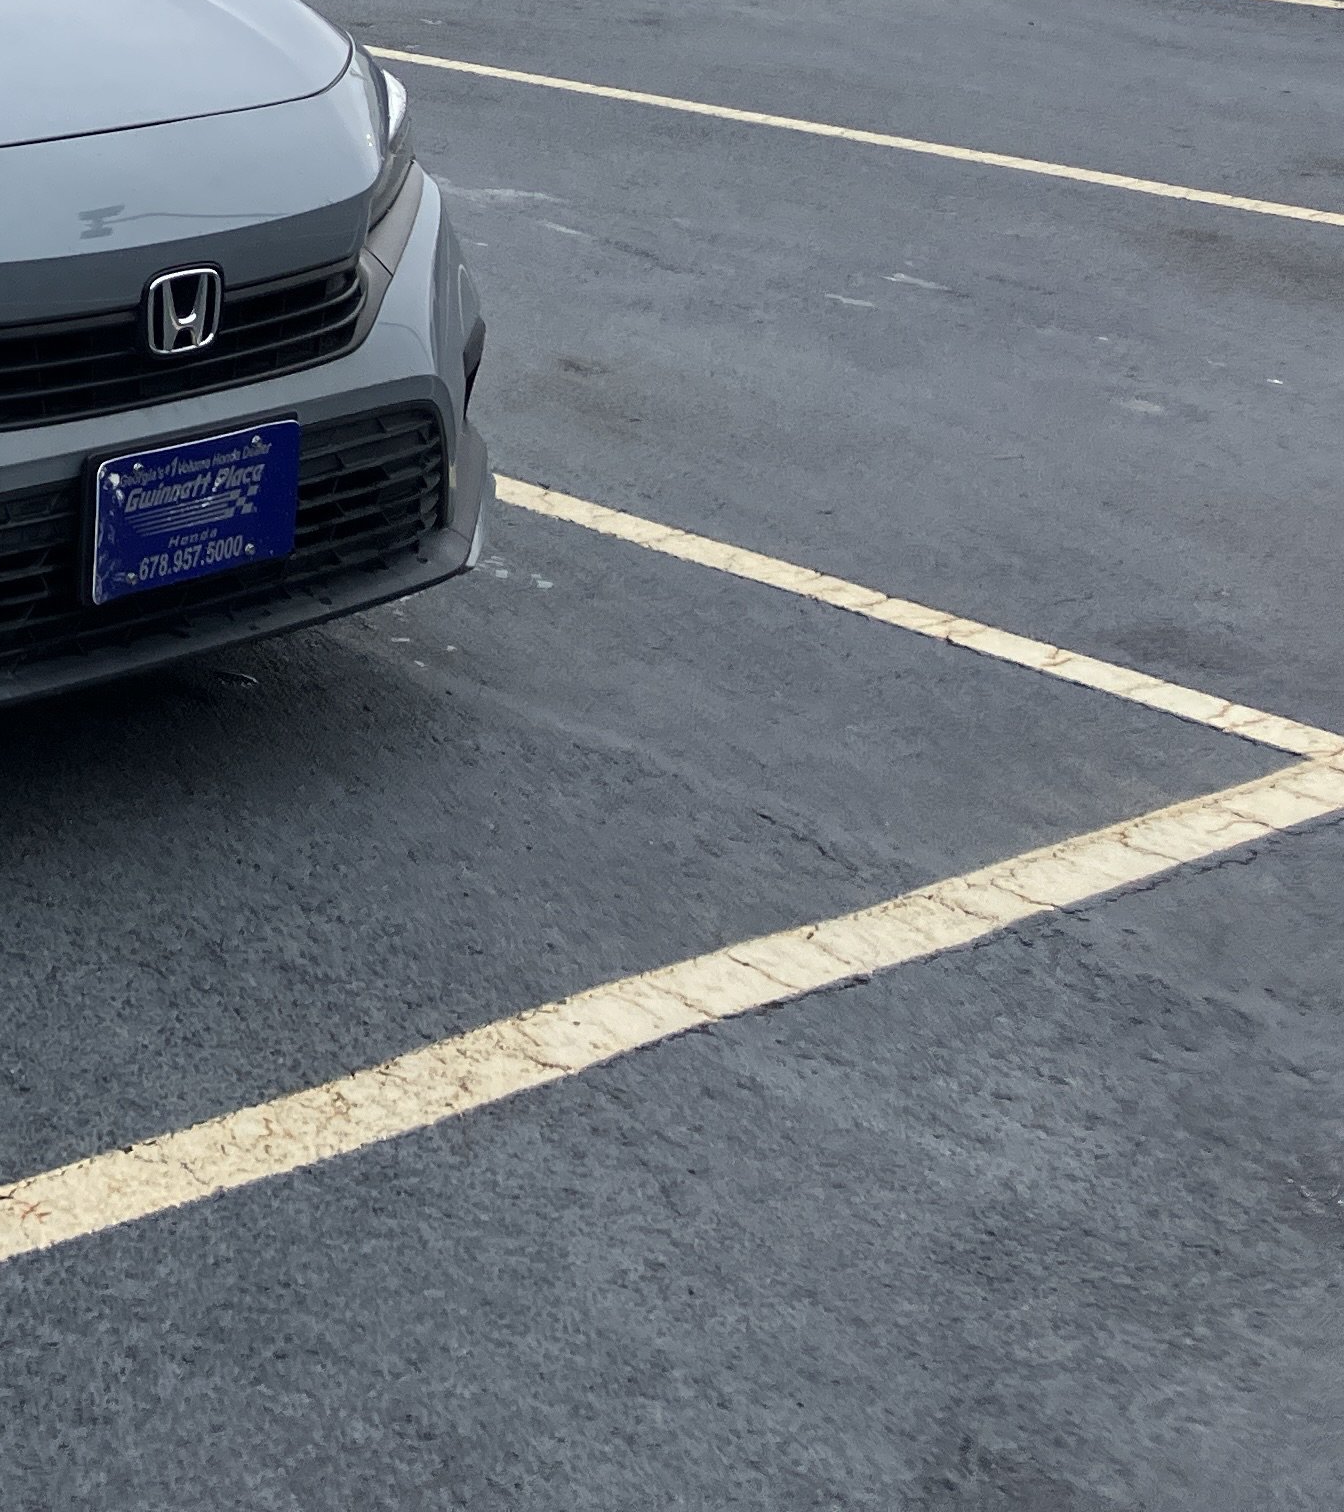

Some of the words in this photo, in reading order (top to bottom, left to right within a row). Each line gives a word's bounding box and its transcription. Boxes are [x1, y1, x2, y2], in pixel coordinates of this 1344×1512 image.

[211, 447, 241, 466] Honda
[124, 471, 213, 513] Gwinnett
[212, 464, 266, 491] Place
[167, 527, 218, 548] Honda
[139, 534, 243, 581] 678.957.5000
